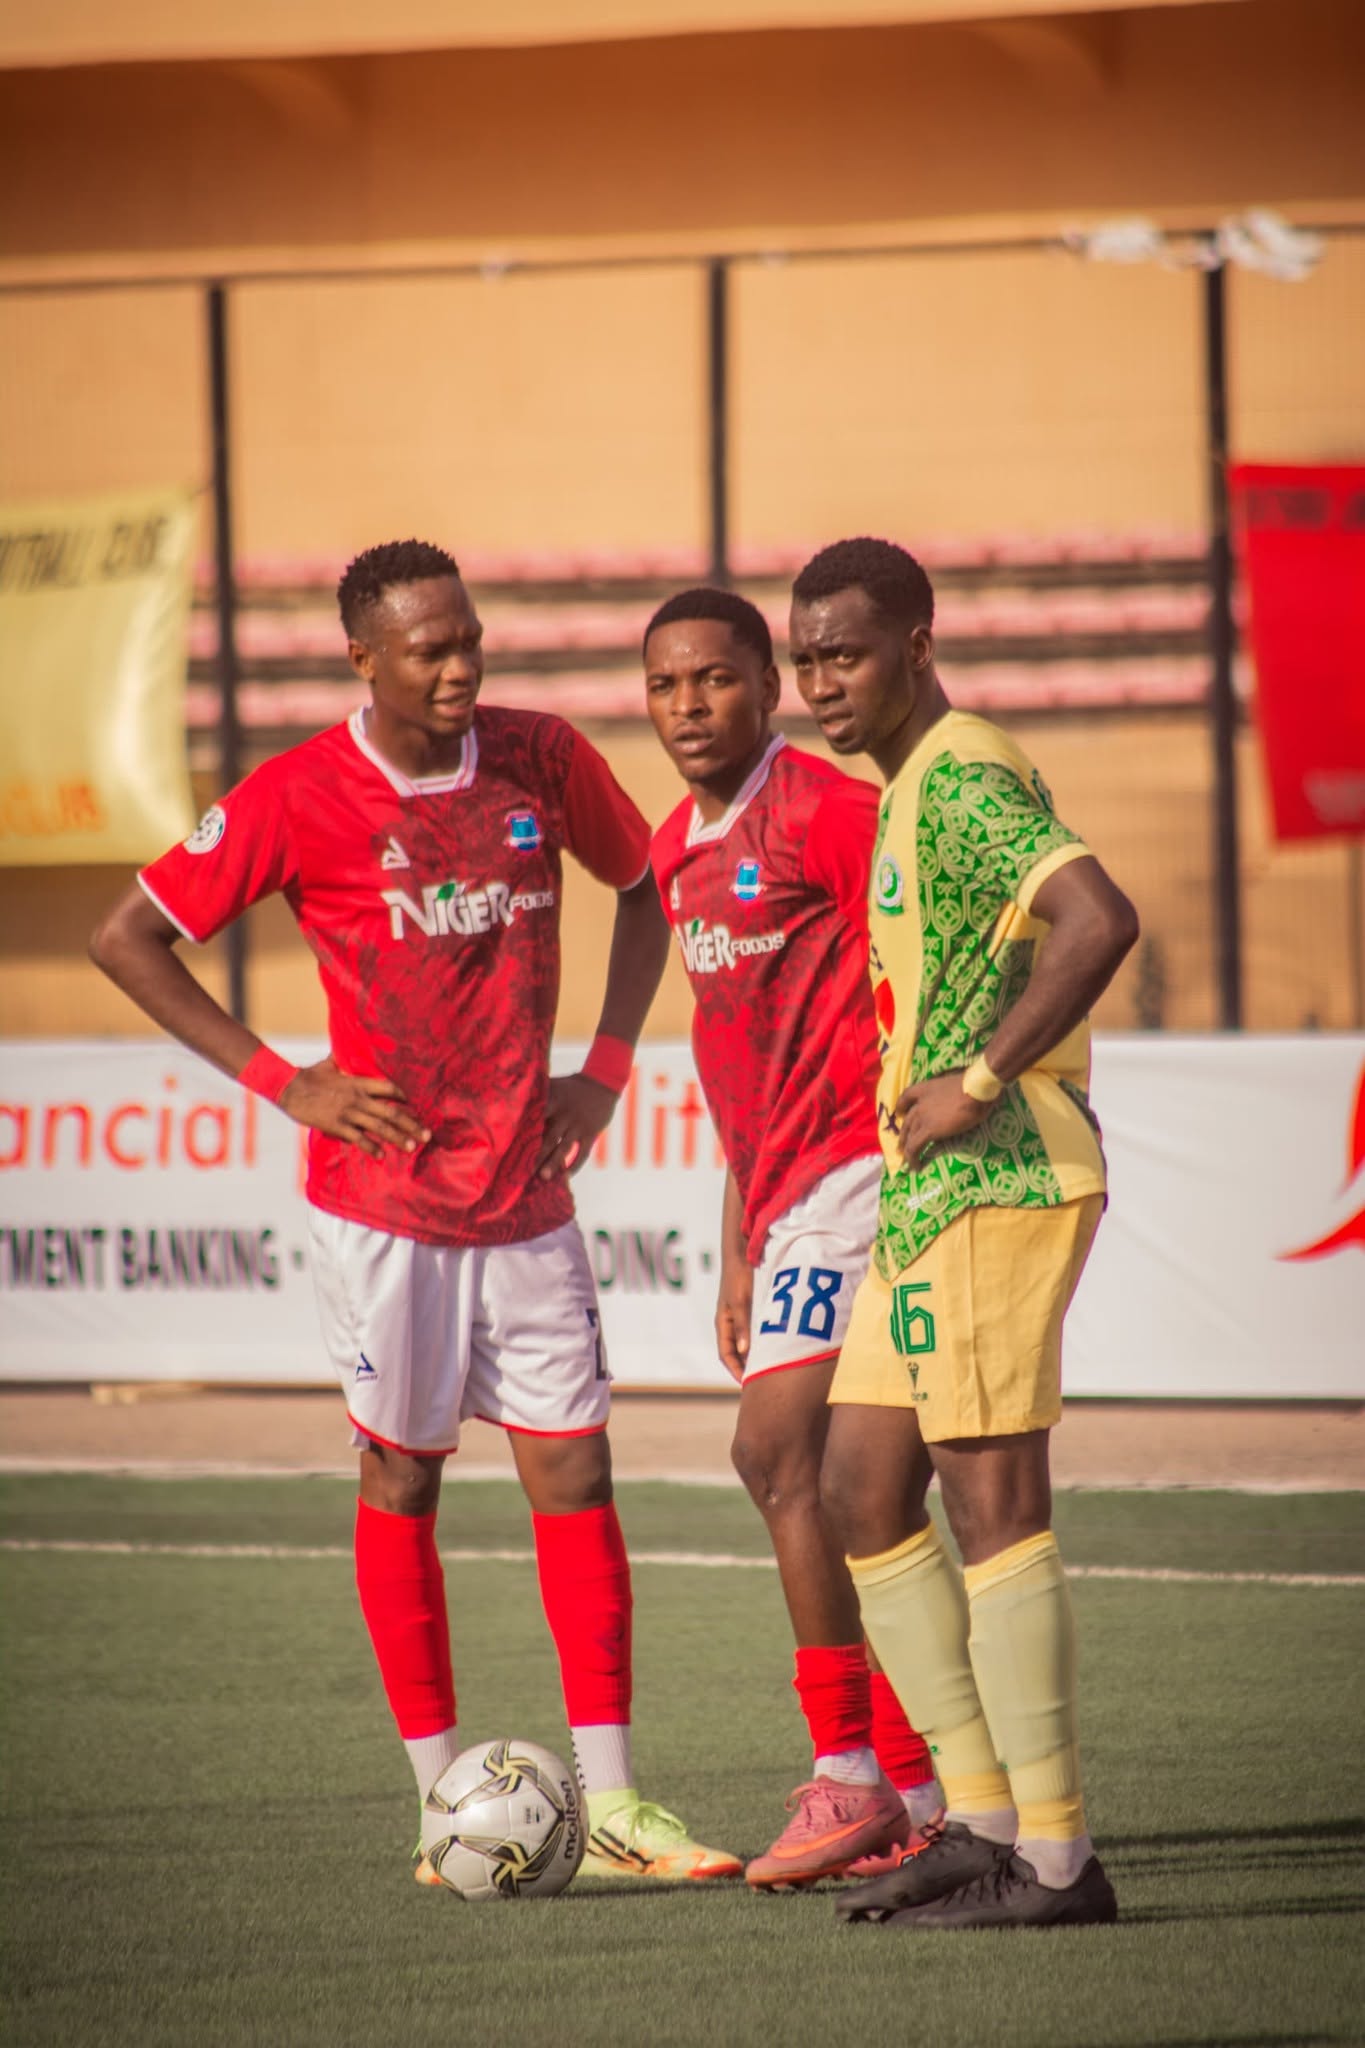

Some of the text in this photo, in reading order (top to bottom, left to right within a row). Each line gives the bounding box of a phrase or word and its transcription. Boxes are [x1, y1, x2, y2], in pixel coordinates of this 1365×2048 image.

[730, 931, 785, 958] FOODS
[119, 1227, 282, 1291] BANKING
[761, 1267, 843, 1341] 38
[890, 1281, 936, 1356] 16
[560, 1780, 578, 1860] molten
